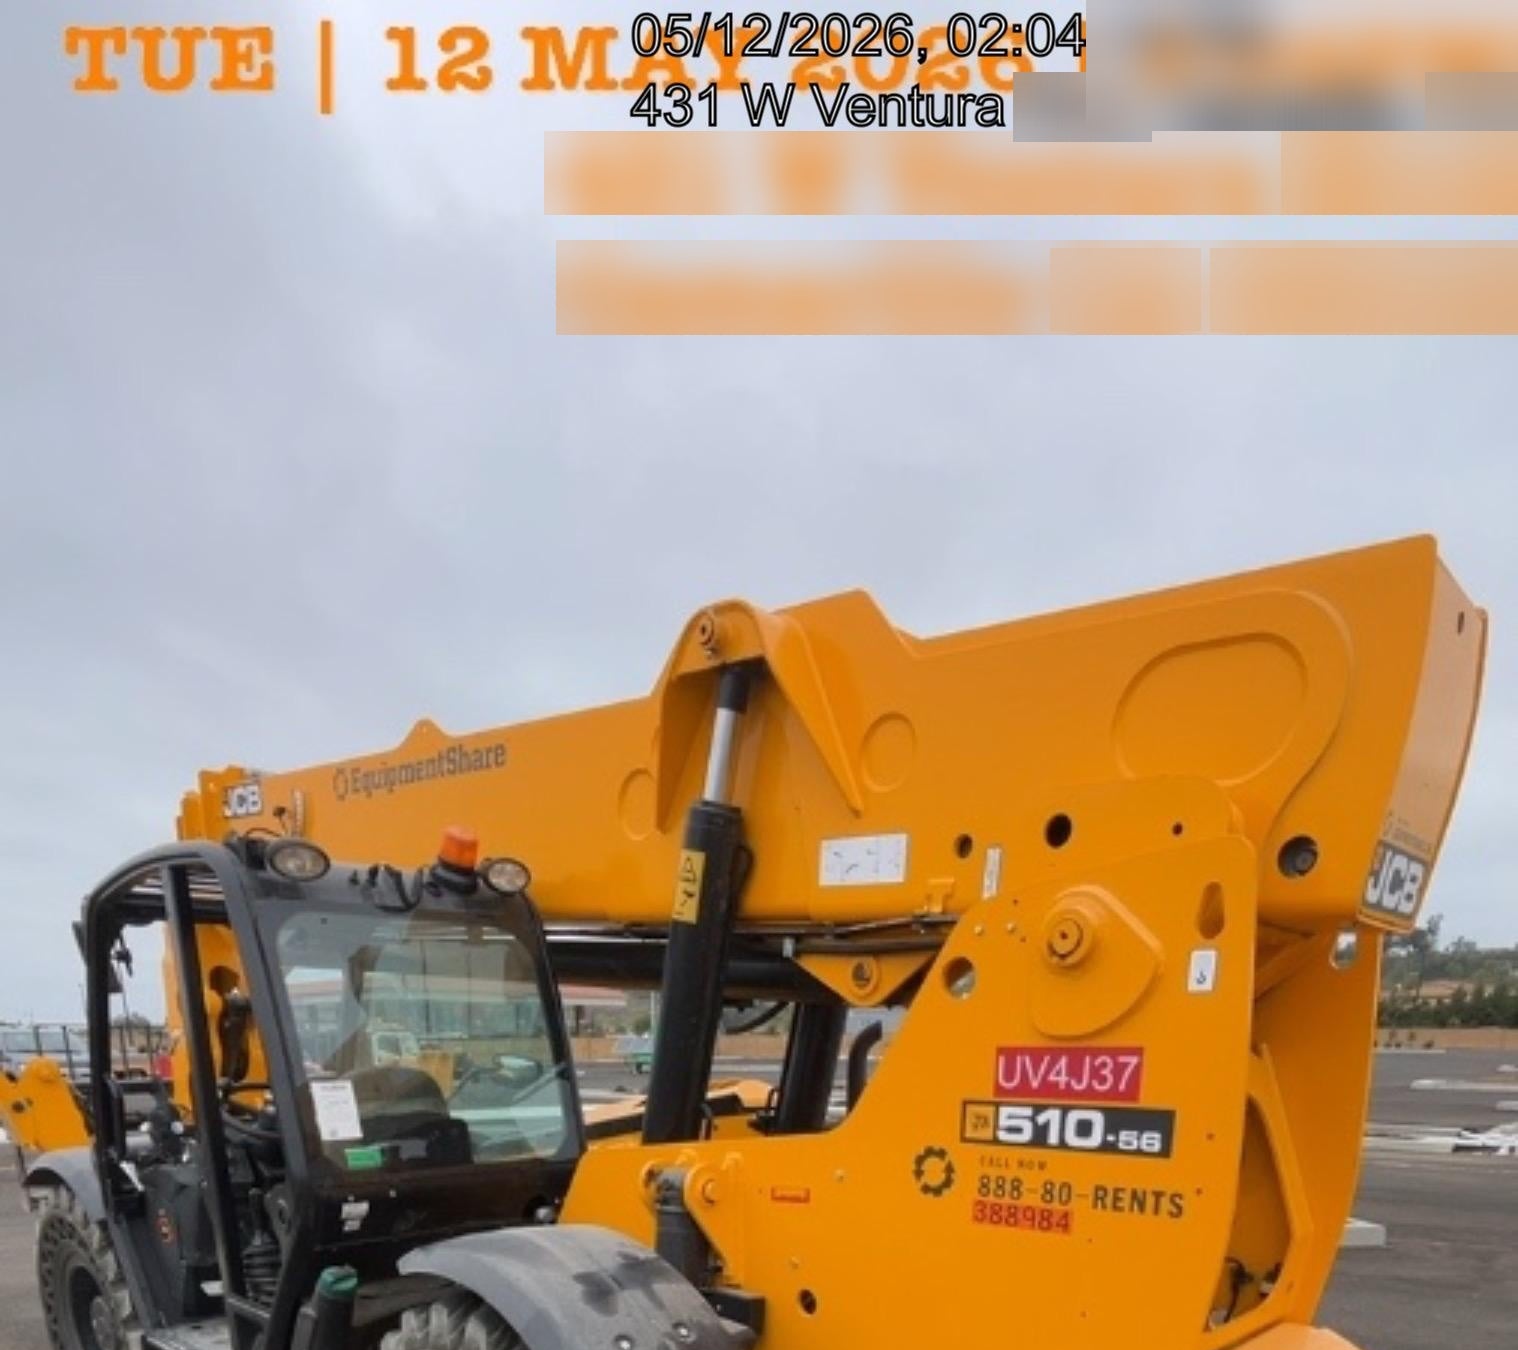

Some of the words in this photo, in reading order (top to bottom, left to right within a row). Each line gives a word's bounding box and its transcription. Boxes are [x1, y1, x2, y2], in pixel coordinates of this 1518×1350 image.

[350, 743, 507, 798] EquipmentShare
[224, 785, 263, 817] JCB
[1366, 848, 1426, 914] JCB
[998, 1054, 1141, 1092] UV4J37
[973, 1201, 1072, 1234] 388984
[977, 1175, 1184, 1219] 888-80-RENTS
